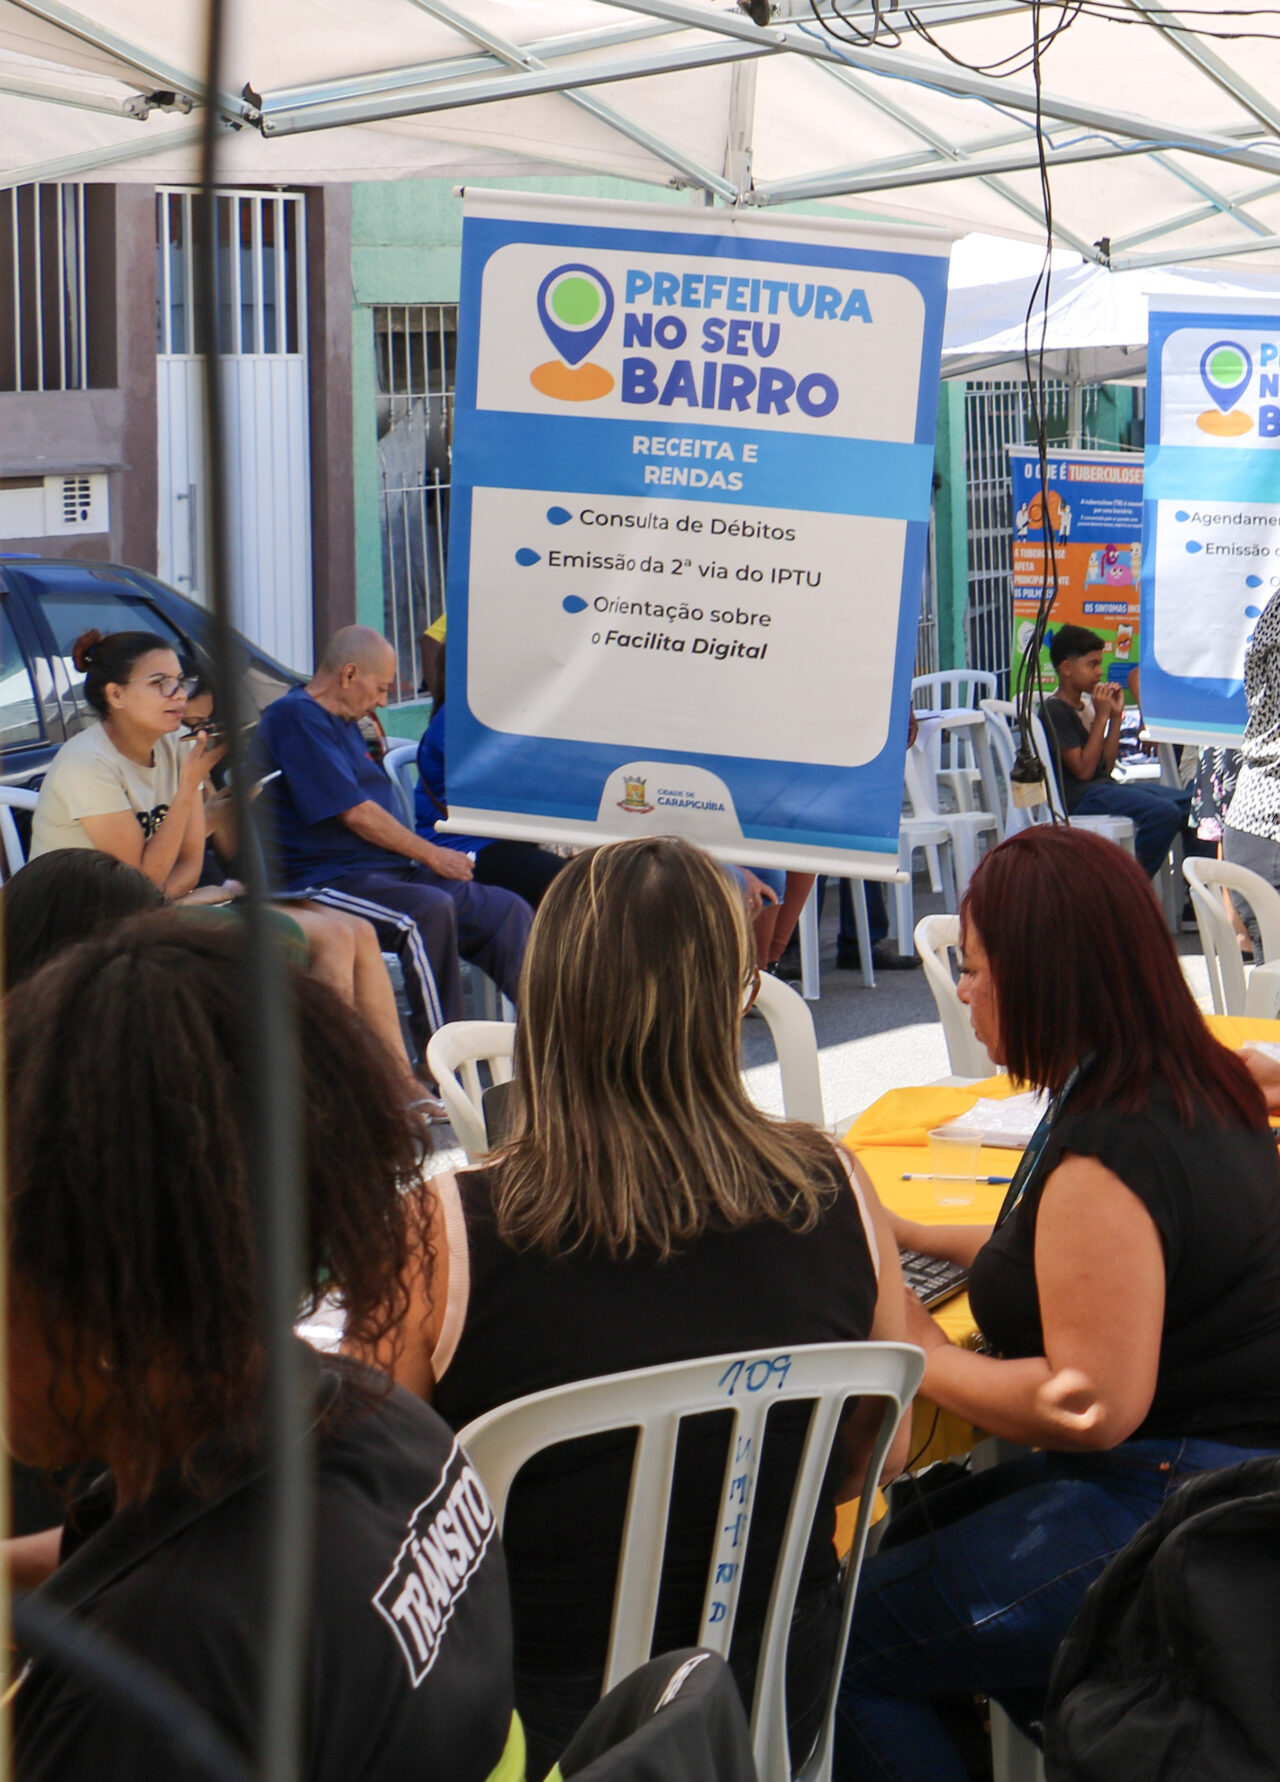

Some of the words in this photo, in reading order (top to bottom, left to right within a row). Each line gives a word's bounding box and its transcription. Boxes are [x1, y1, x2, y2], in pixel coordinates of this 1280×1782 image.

[625, 269, 873, 324] PREFEITURA
[623, 312, 687, 350] NO
[701, 319, 781, 358] SEU
[621, 356, 839, 418] BAIRRO
[632, 436, 734, 462] RECEITA
[743, 444, 758, 463] E
[644, 465, 743, 492] RENDAS
[1024, 463, 1032, 479] O
[1059, 462, 1067, 480] É
[579, 508, 669, 533] Consulta
[676, 515, 704, 534] de
[710, 517, 797, 542] Débitos
[1206, 542, 1270, 557] Emissão
[548, 550, 636, 572] Emissão
[640, 555, 664, 575] da
[670, 557, 692, 576] 2ª
[698, 561, 728, 580] via
[735, 564, 763, 584] do
[770, 567, 822, 588] IPTU
[594, 596, 704, 626] Orientação
[710, 605, 772, 628] sobre
[591, 632, 600, 646] o
[604, 630, 685, 653] Facilita
[692, 637, 768, 662] Digital
[657, 797, 725, 812] CARAPICUÍBA
[391, 1465, 491, 1662] TRÂNSITO
